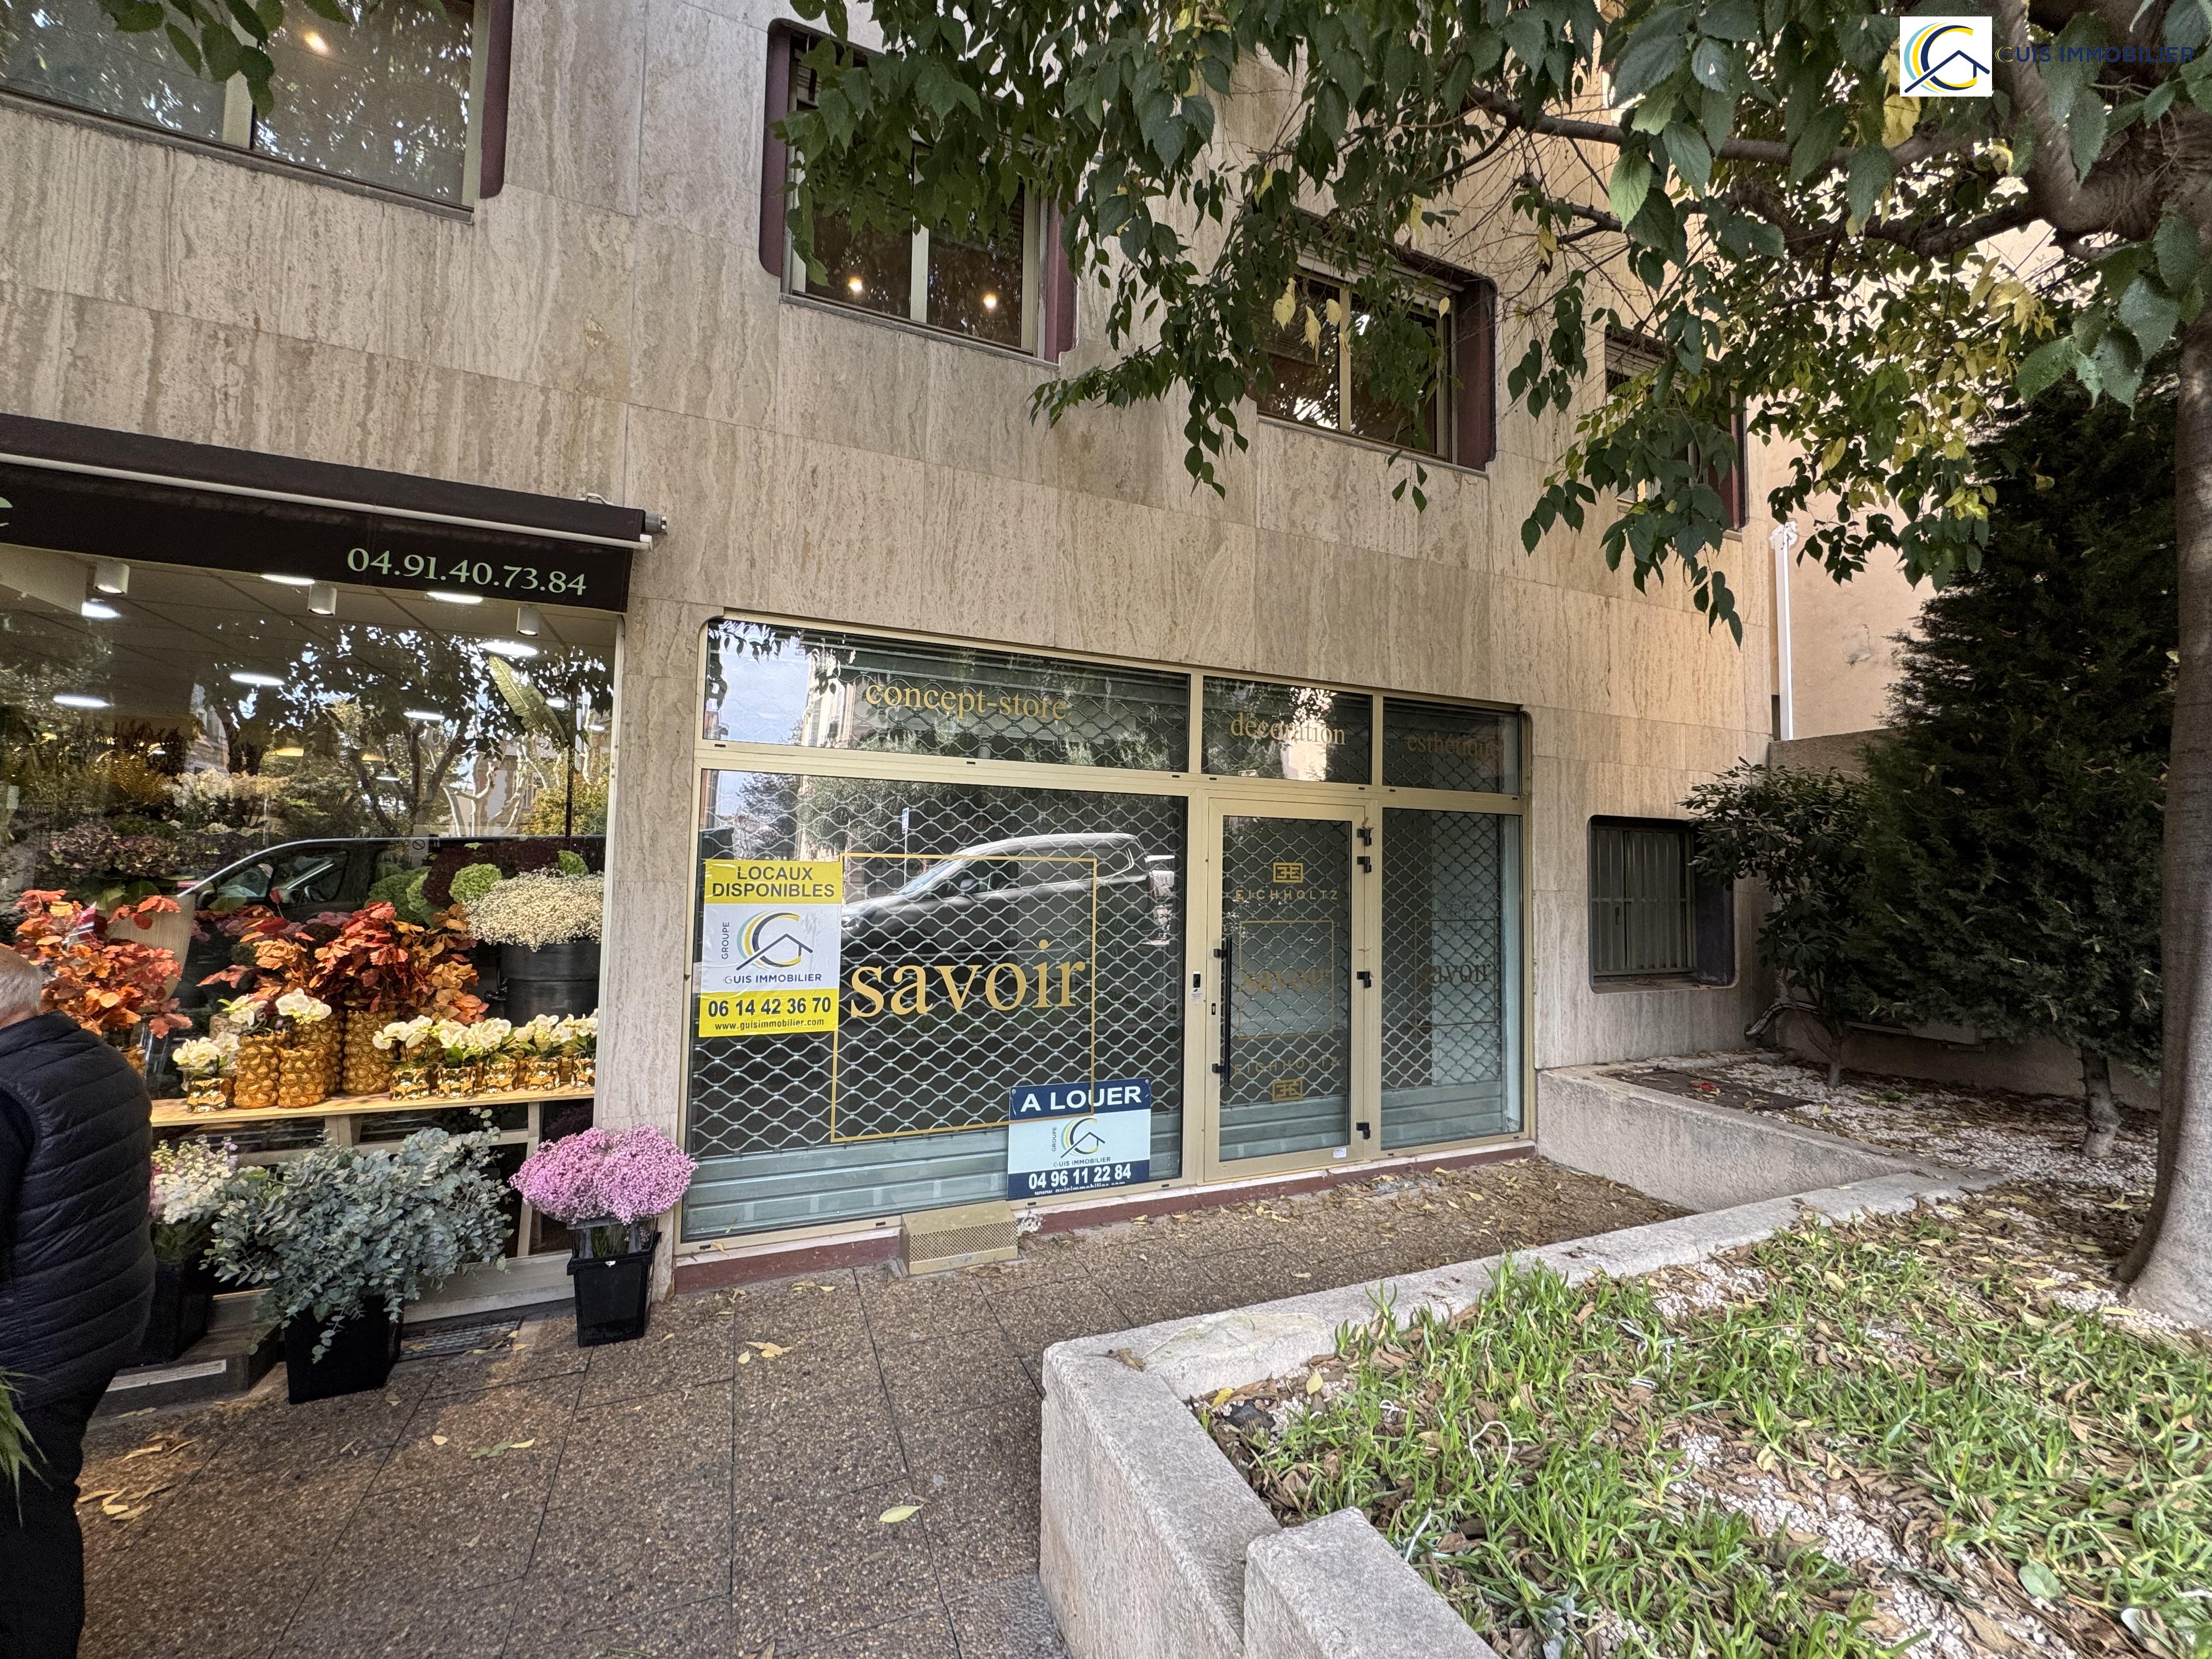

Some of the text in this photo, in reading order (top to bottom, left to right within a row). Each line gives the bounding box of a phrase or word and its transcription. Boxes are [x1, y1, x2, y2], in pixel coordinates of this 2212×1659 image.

[347, 548, 586, 595] 04.91.40.73.84
[866, 684, 1066, 720] concept-store
[737, 866, 813, 881] LOCAUX
[713, 883, 835, 898] DISPONIBLES
[1235, 889, 1338, 900] EICHHOLTZ
[721, 921, 730, 960] GROUPE
[724, 974, 822, 984] GUIS IMMOBILIER
[850, 939, 1086, 1018] savoir
[1422, 955, 1492, 984] avoir
[708, 997, 831, 1017] 06 14 42 36 70
[715, 1019, 824, 1031] www.guisimmobilier.com
[1234, 1056, 1339, 1075] EICHHOLTZ
[1020, 1086, 1142, 1112] A LOUER
[1071, 1156, 1111, 1166] IMMOBILIER
[1029, 1163, 1131, 1189] 04 96 11 22 84
